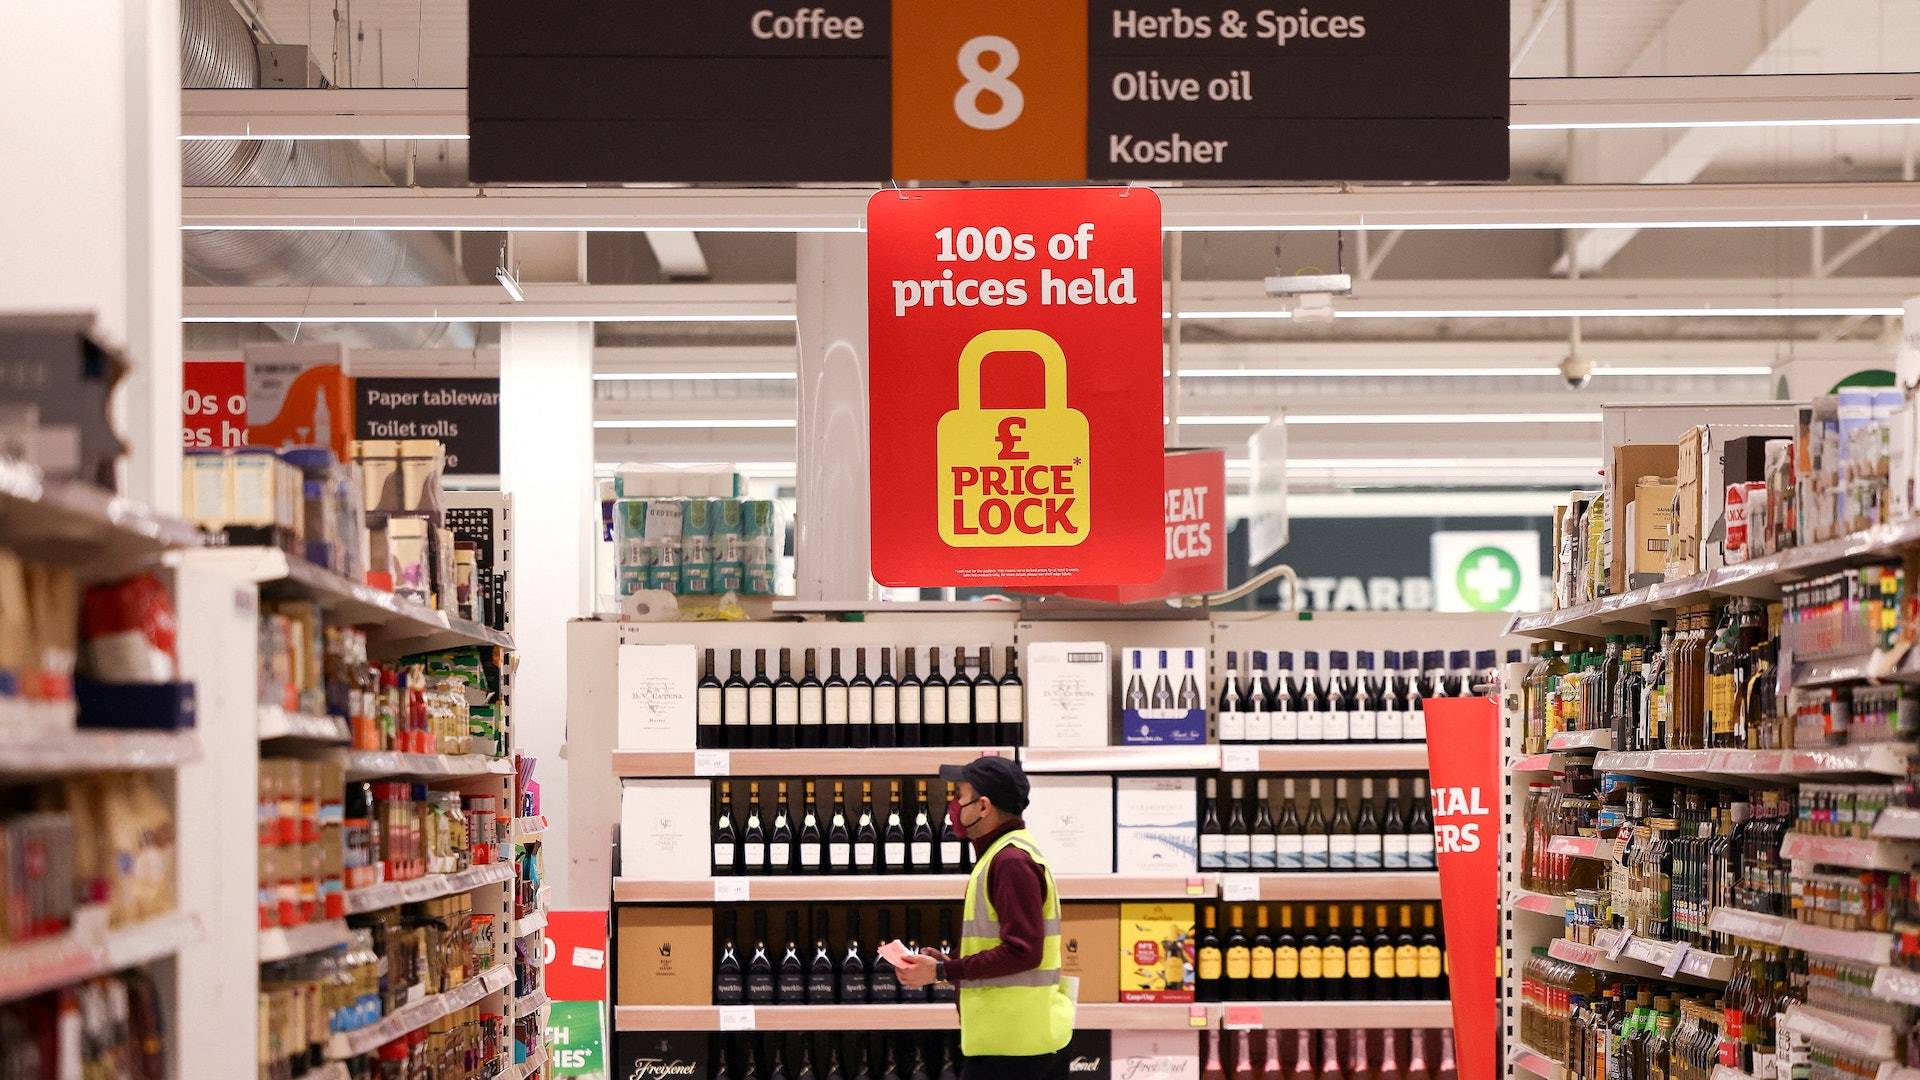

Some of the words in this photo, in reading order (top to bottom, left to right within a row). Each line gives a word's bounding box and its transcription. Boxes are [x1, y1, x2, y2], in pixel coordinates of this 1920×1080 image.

[752, 8, 863, 39] Coffee
[1114, 8, 1211, 39] Herbs
[1220, 10, 1248, 39] &
[1257, 8, 1366, 46] Spices
[954, 36, 1024, 130] 8
[1113, 71, 1199, 100] Olive
[1209, 71, 1252, 100] oil
[1111, 133, 1228, 163] Kosher
[935, 226, 1036, 262] 100s
[1047, 223, 1094, 261] of
[893, 269, 1028, 316] prices
[1042, 268, 1136, 305] held
[182, 389, 219, 415] 0s
[368, 390, 419, 409] Paper
[424, 389, 499, 406] tablewar
[368, 421, 416, 437] Toilet
[421, 421, 458, 437] rolls
[995, 417, 1029, 460] £
[953, 498, 1079, 535] LOCK
[1165, 522, 1213, 560] ICES
[1278, 576, 1432, 611] STARB
[1435, 823, 1481, 853] ERS
[629, 1058, 697, 1080] Freixenet
